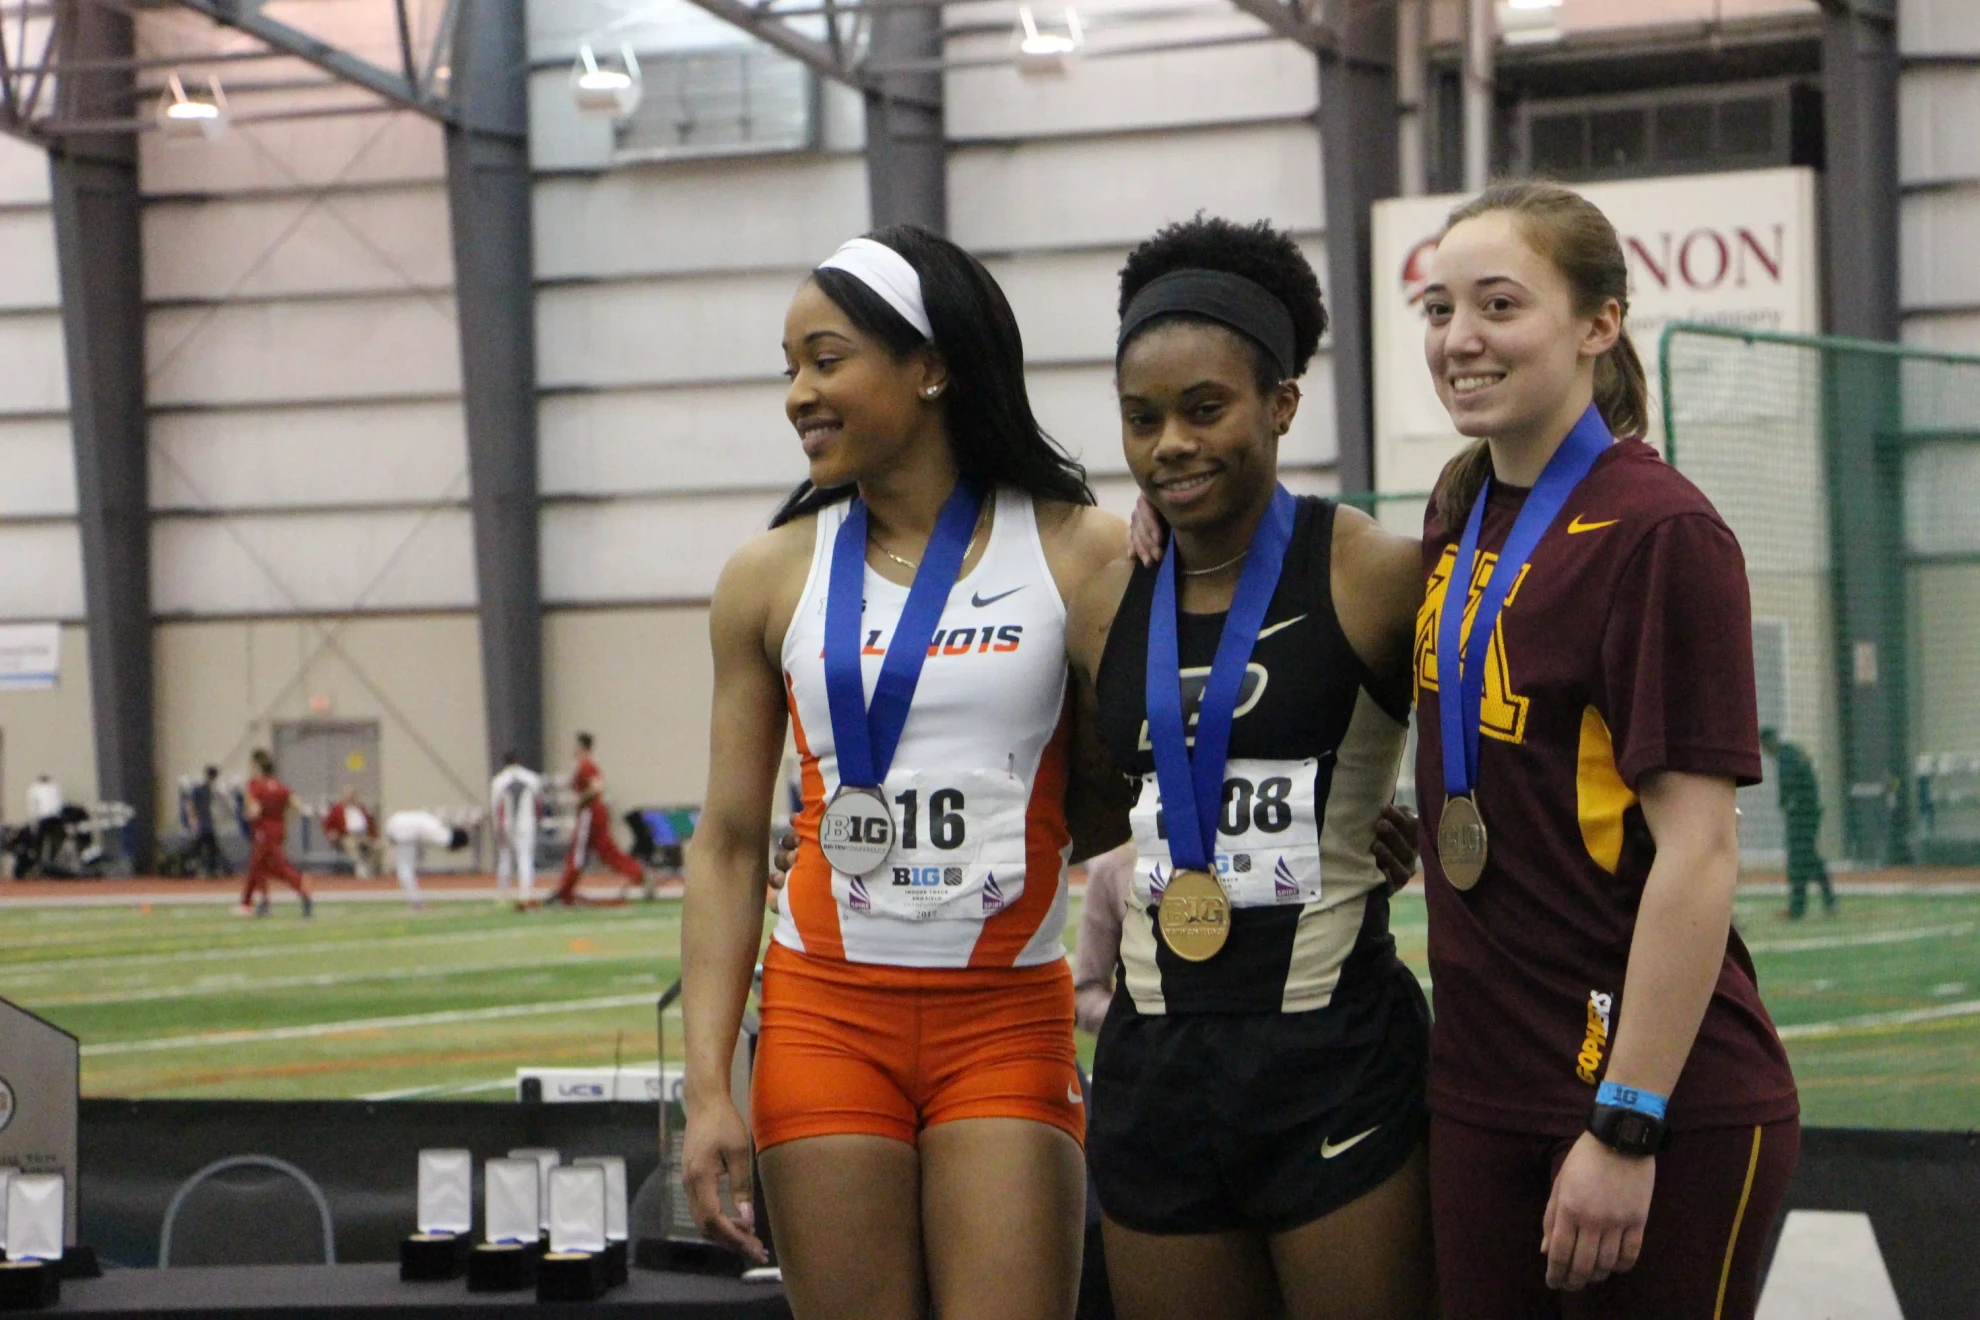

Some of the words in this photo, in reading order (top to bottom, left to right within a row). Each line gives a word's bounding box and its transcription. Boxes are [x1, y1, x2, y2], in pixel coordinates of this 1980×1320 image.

[819, 625, 1024, 660] LNOIS
[895, 787, 965, 850] 16
[1157, 777, 1293, 839] 08
[1577, 989, 1612, 1086] GOPHERS
